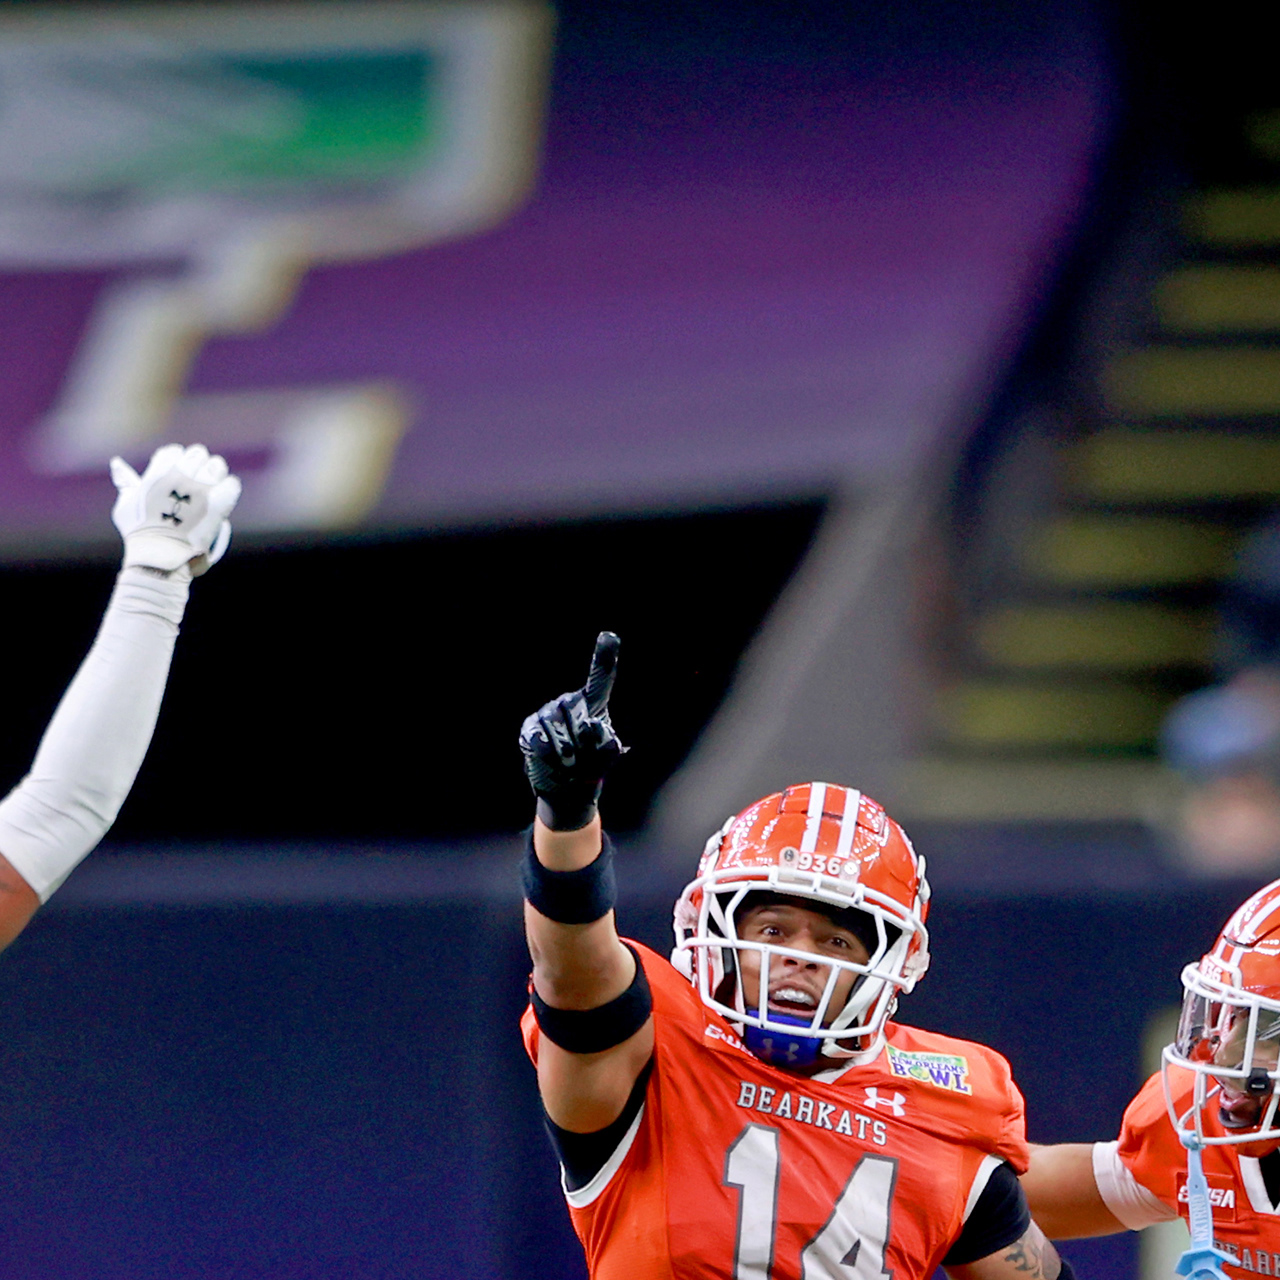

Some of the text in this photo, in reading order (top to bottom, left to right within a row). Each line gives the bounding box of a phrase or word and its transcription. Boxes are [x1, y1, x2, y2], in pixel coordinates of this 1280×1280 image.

[798, 852, 842, 876] 936
[892, 1061, 969, 1092] BOWL
[915, 1060, 966, 1075] ORLEANS
[736, 1080, 888, 1147] BEARKATS
